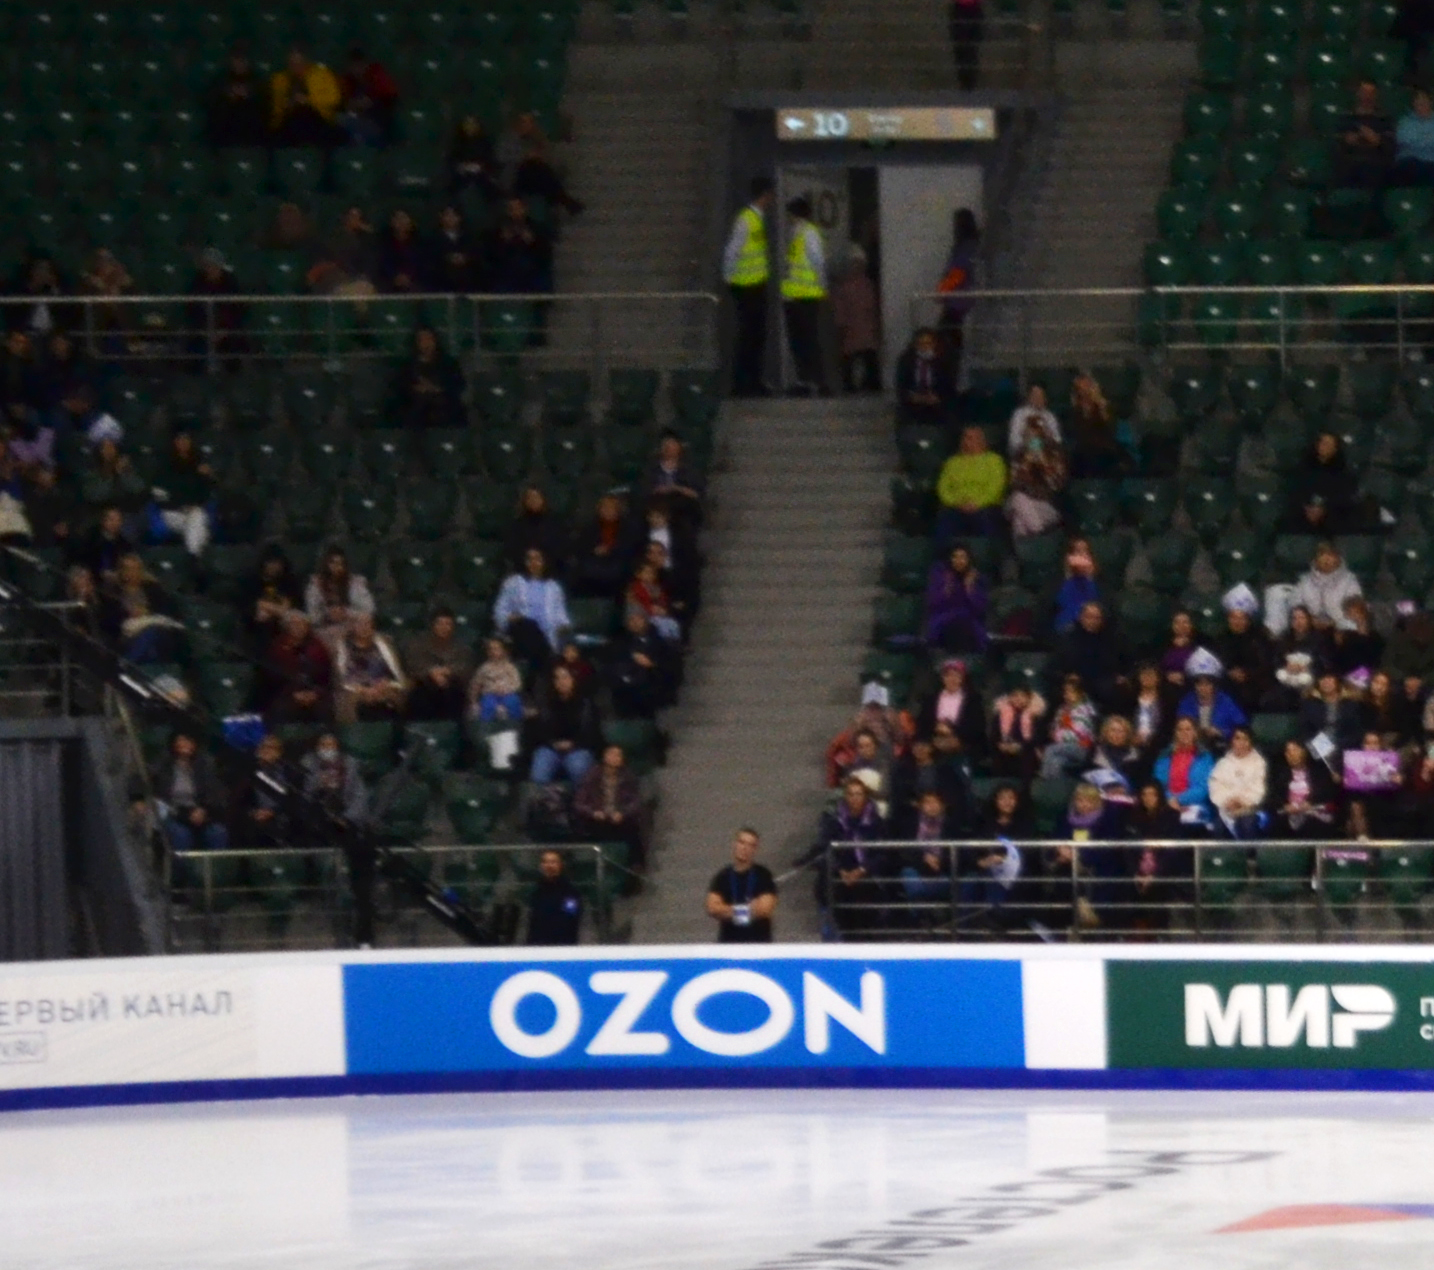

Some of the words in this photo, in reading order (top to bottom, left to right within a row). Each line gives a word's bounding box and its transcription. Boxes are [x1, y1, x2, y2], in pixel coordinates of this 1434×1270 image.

[812, 112, 849, 137] 10
[123, 990, 233, 1019] КАНАЛ
[489, 967, 887, 1058] OZON
[1184, 983, 1396, 1048] МИР
